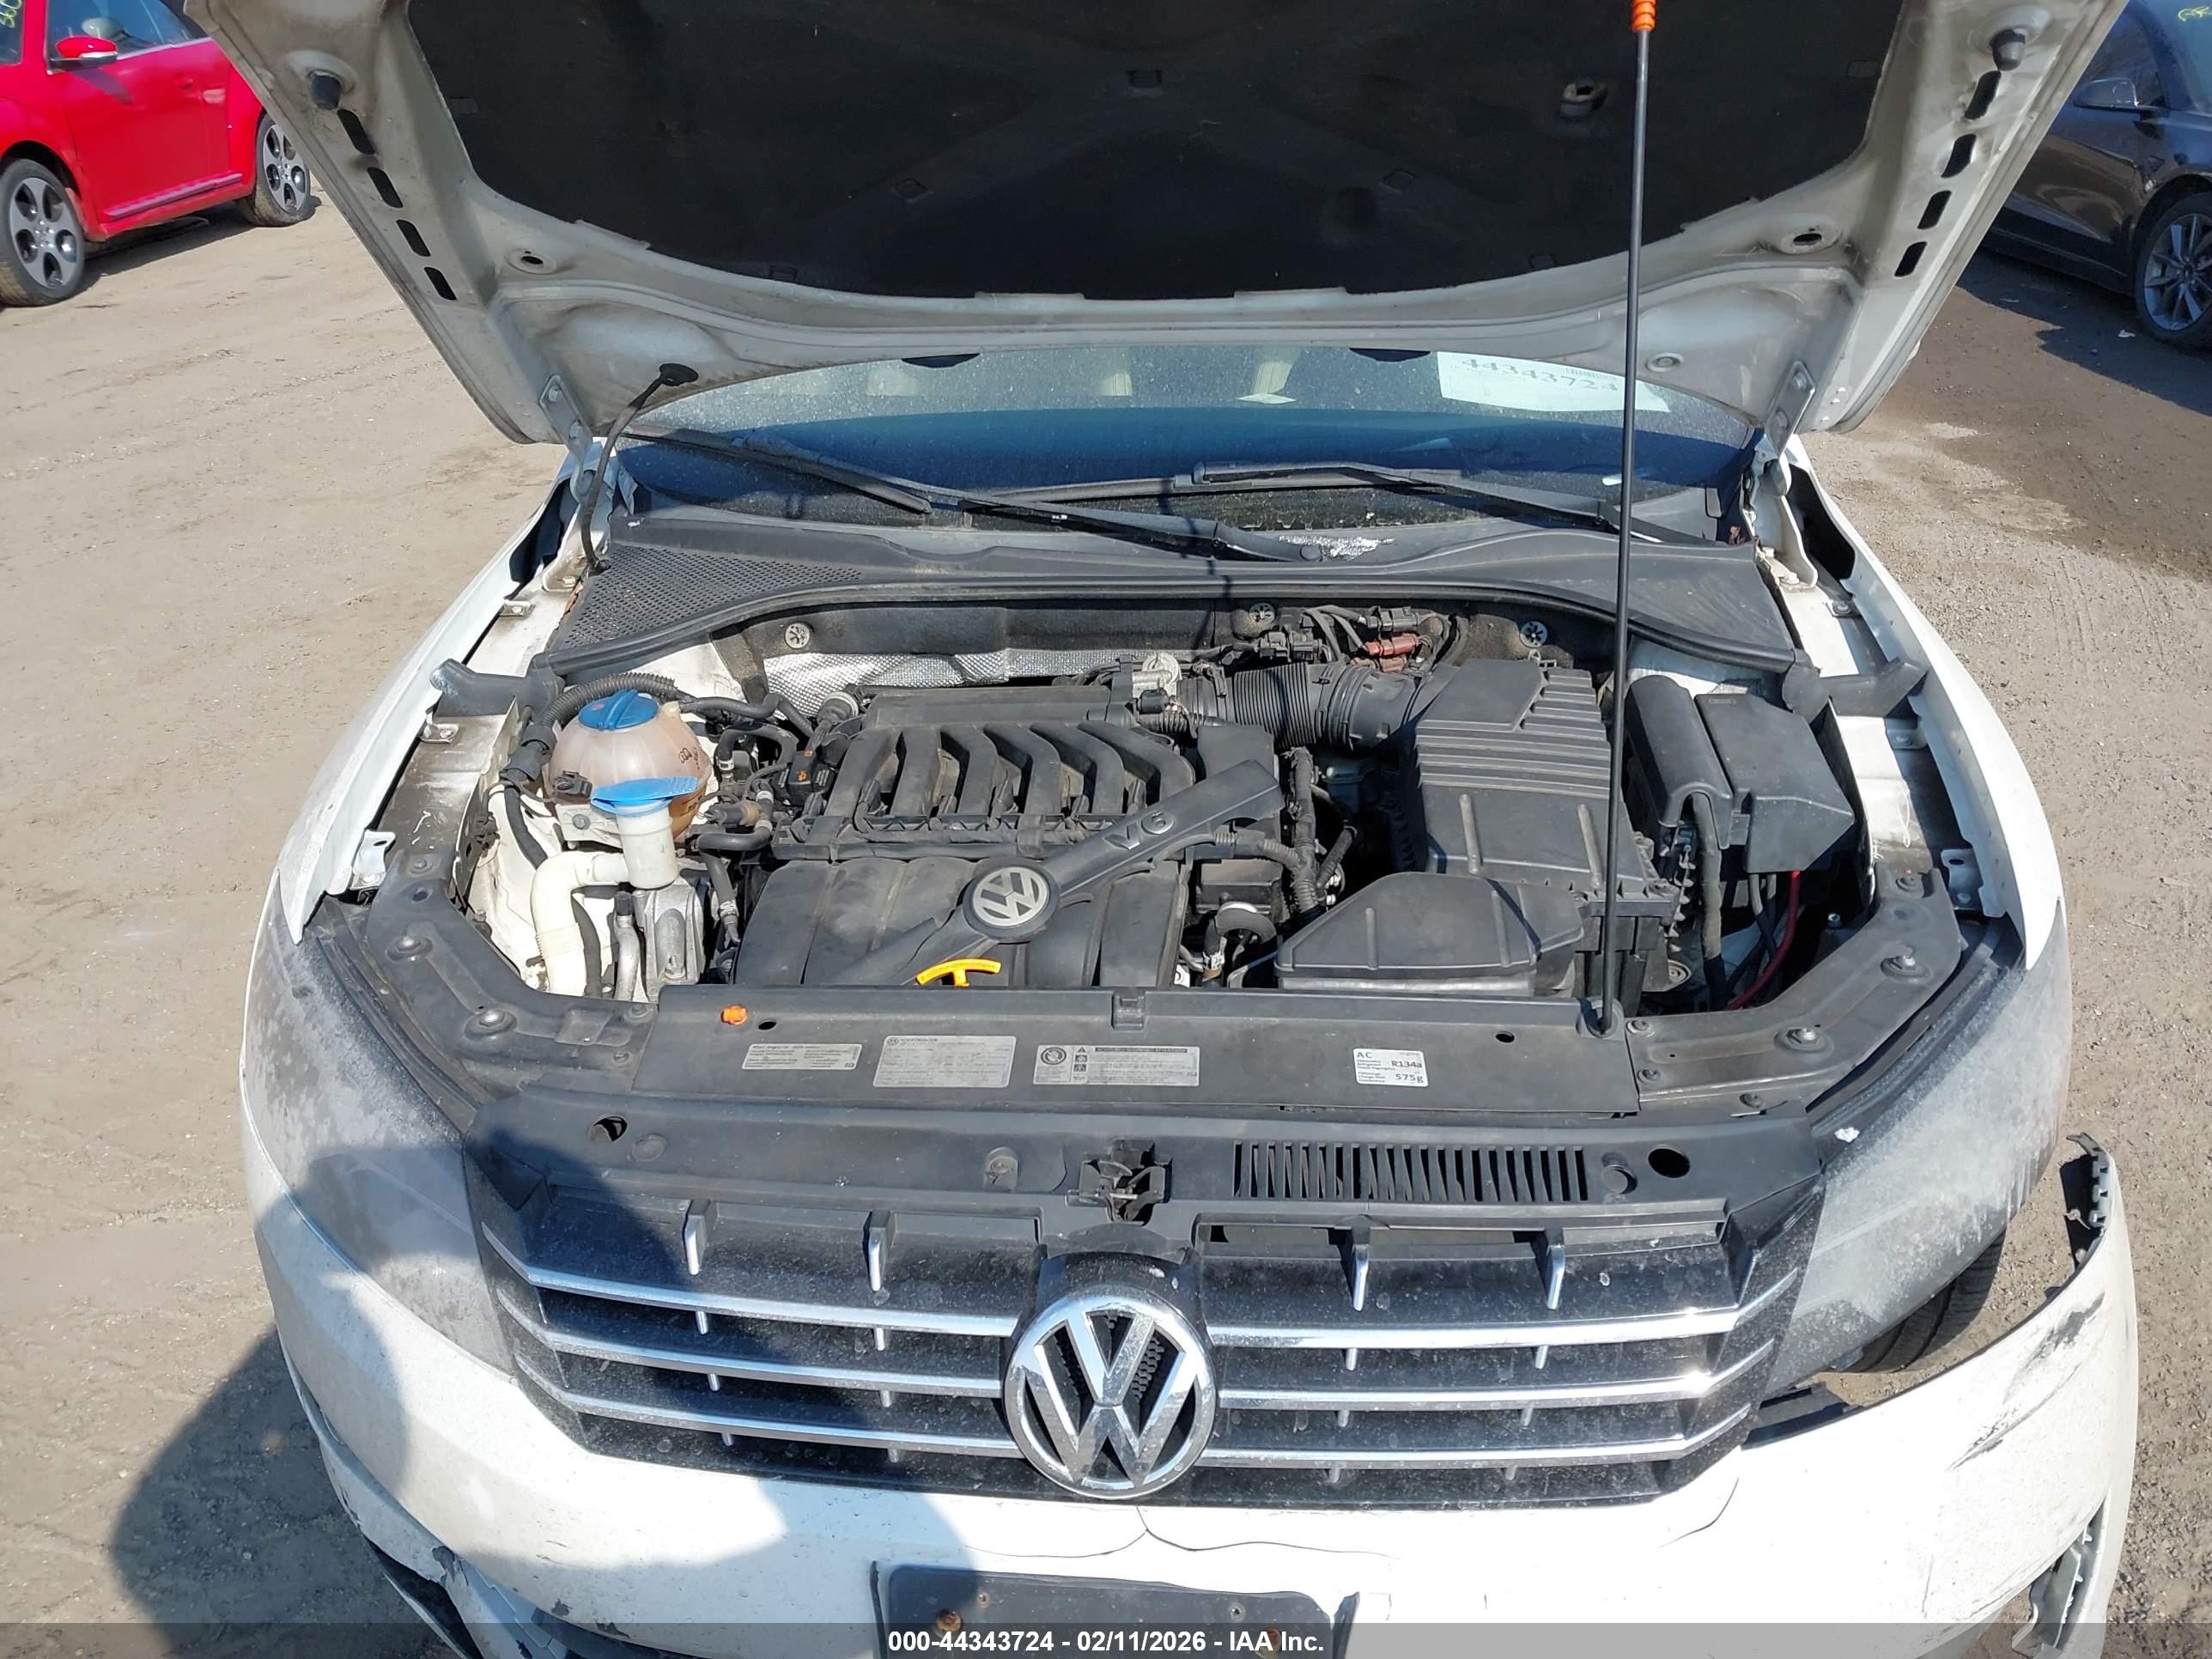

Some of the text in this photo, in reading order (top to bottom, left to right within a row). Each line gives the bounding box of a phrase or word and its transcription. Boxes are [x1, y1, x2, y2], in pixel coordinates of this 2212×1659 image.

[1462, 359, 1618, 391] 44343724
[1103, 811, 1175, 850] V6
[1391, 1060, 1423, 1068] R134a
